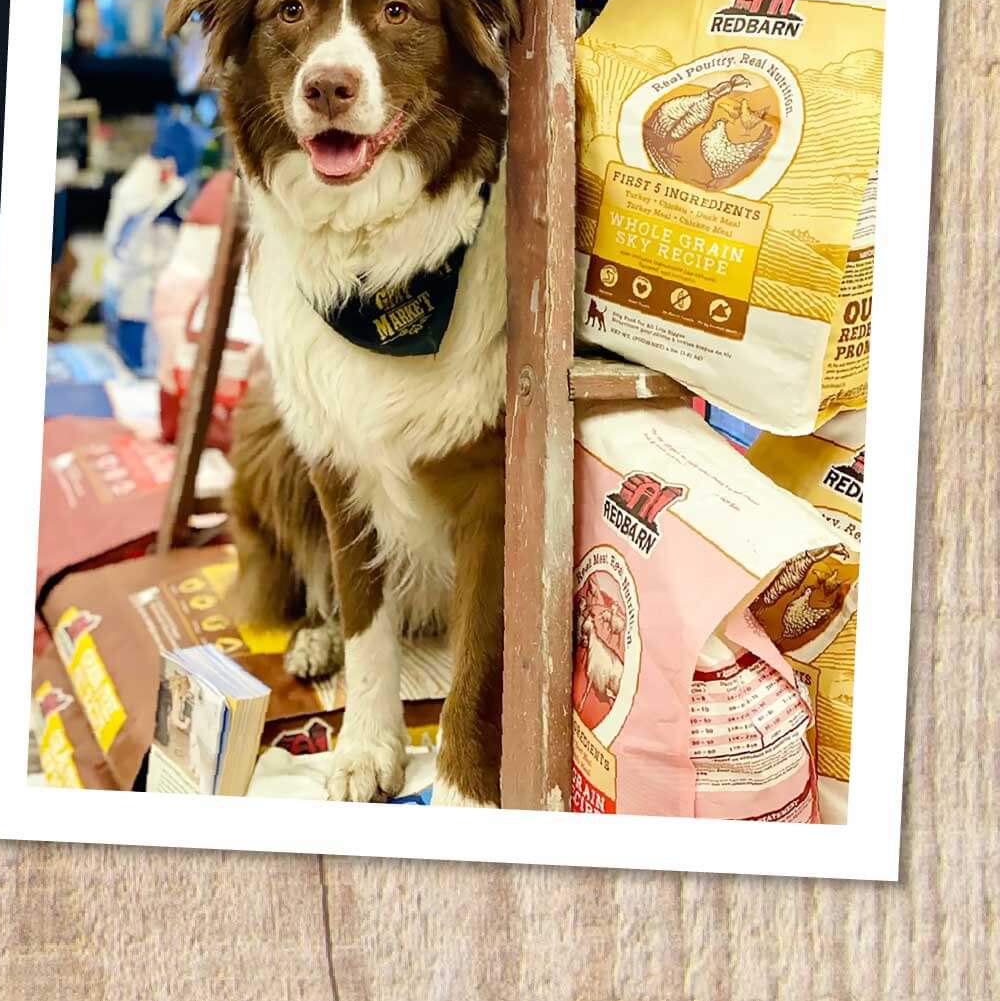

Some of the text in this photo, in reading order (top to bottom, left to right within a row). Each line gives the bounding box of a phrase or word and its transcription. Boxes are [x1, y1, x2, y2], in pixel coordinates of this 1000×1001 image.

[710, 16, 800, 37] REDBARN
[651, 74, 683, 92] Real
[685, 56, 737, 78] Poultry.
[740, 53, 766, 69] Real
[612, 171, 761, 221] FIRST 5 INGREDIENTS
[609, 211, 744, 264] WHOLE GRAIN
[615, 230, 652, 252] SKY
[657, 242, 728, 276] RECIPE
[373, 291, 435, 341] MARKET
[823, 468, 863, 503] RED
[603, 500, 656, 554] REDBARN
